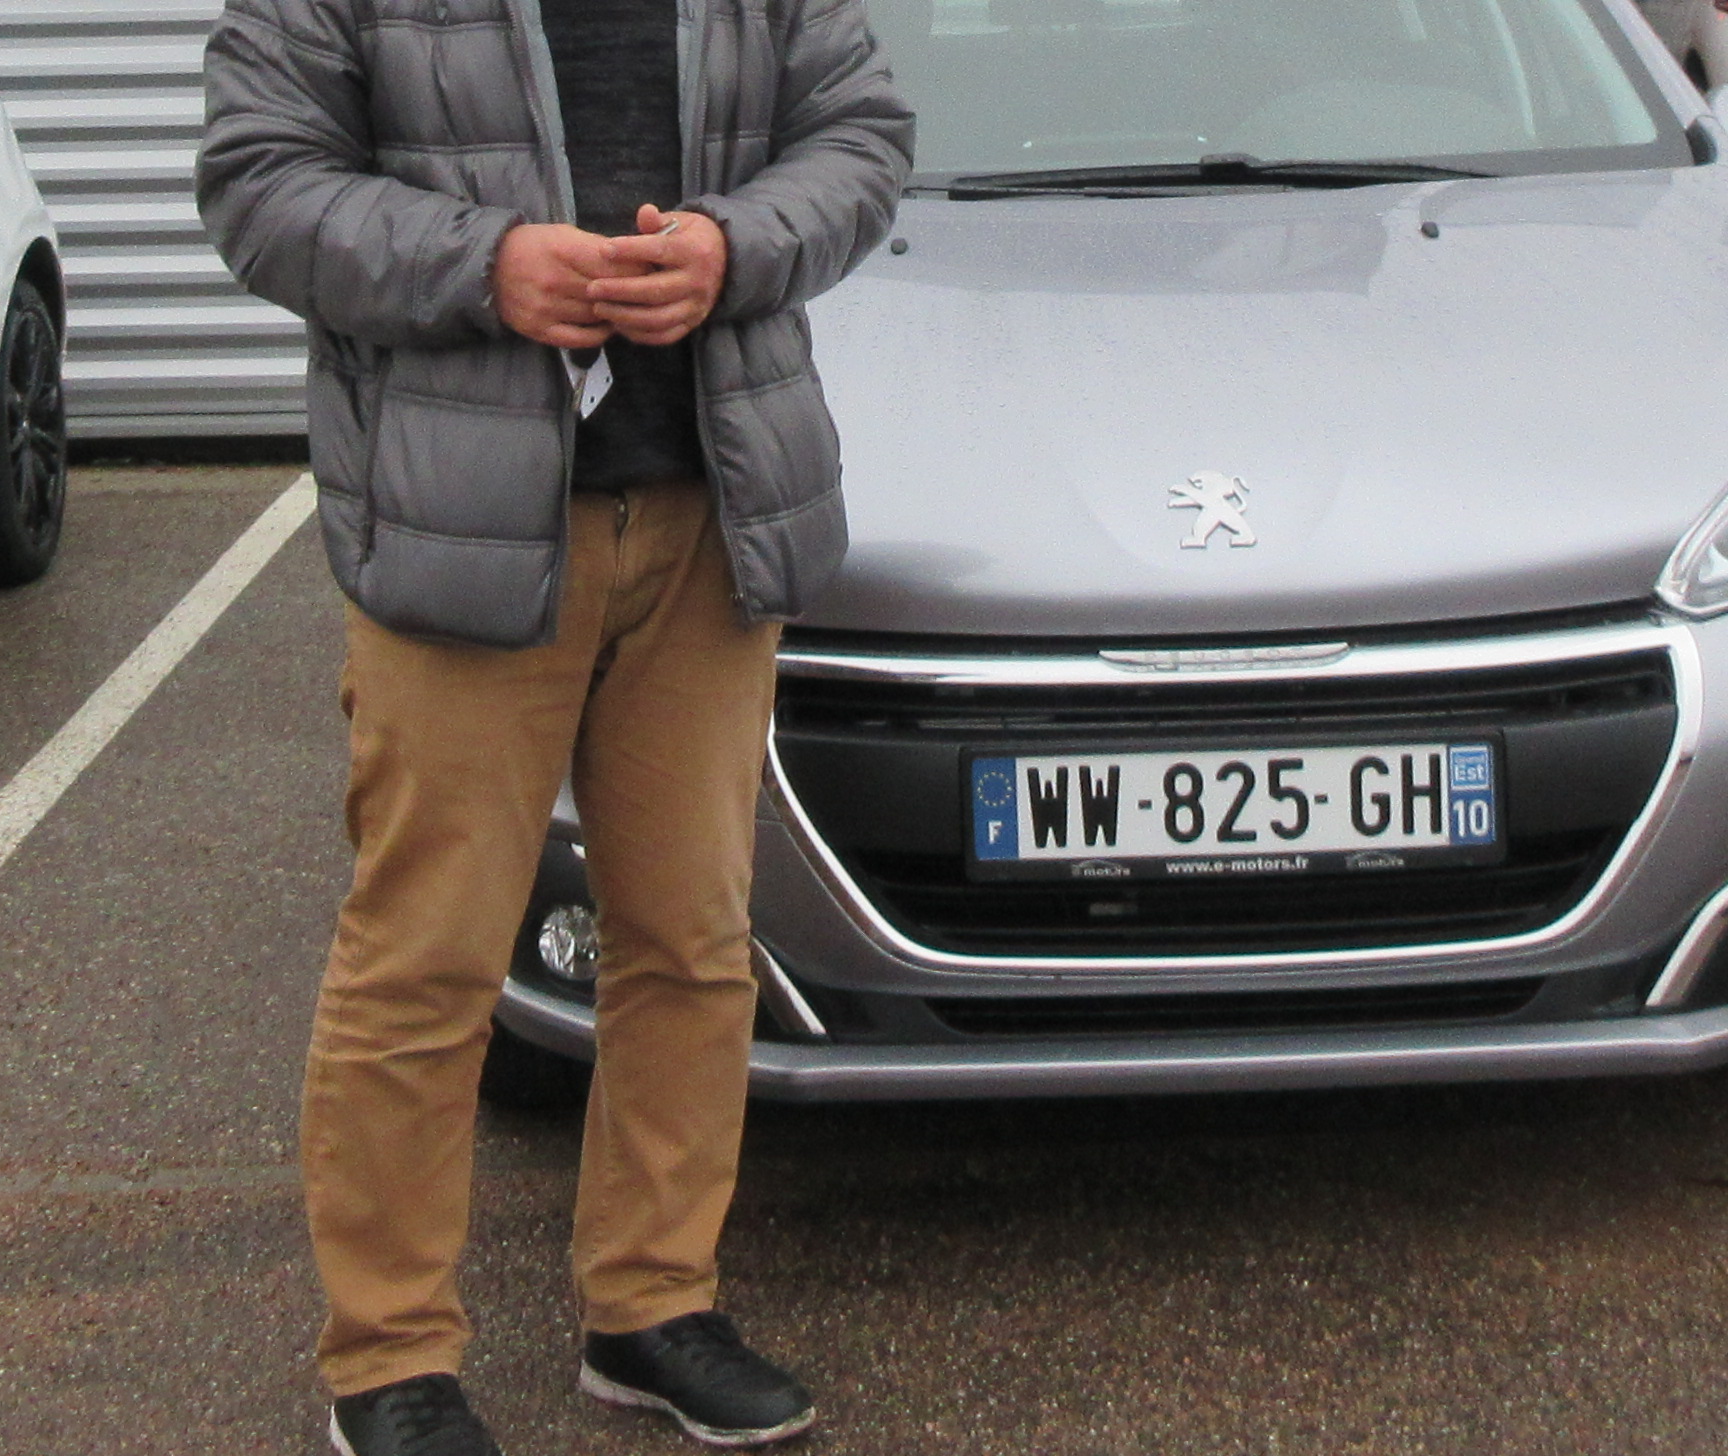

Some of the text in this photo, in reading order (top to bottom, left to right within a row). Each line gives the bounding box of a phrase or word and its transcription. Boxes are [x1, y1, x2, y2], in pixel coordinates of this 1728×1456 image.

[1454, 763, 1485, 781] Est
[1026, 752, 1444, 848] WW-825-GH
[1453, 799, 1489, 837] 10
[987, 821, 1003, 844] F
[1166, 855, 1309, 874] www.e-motors.fr
